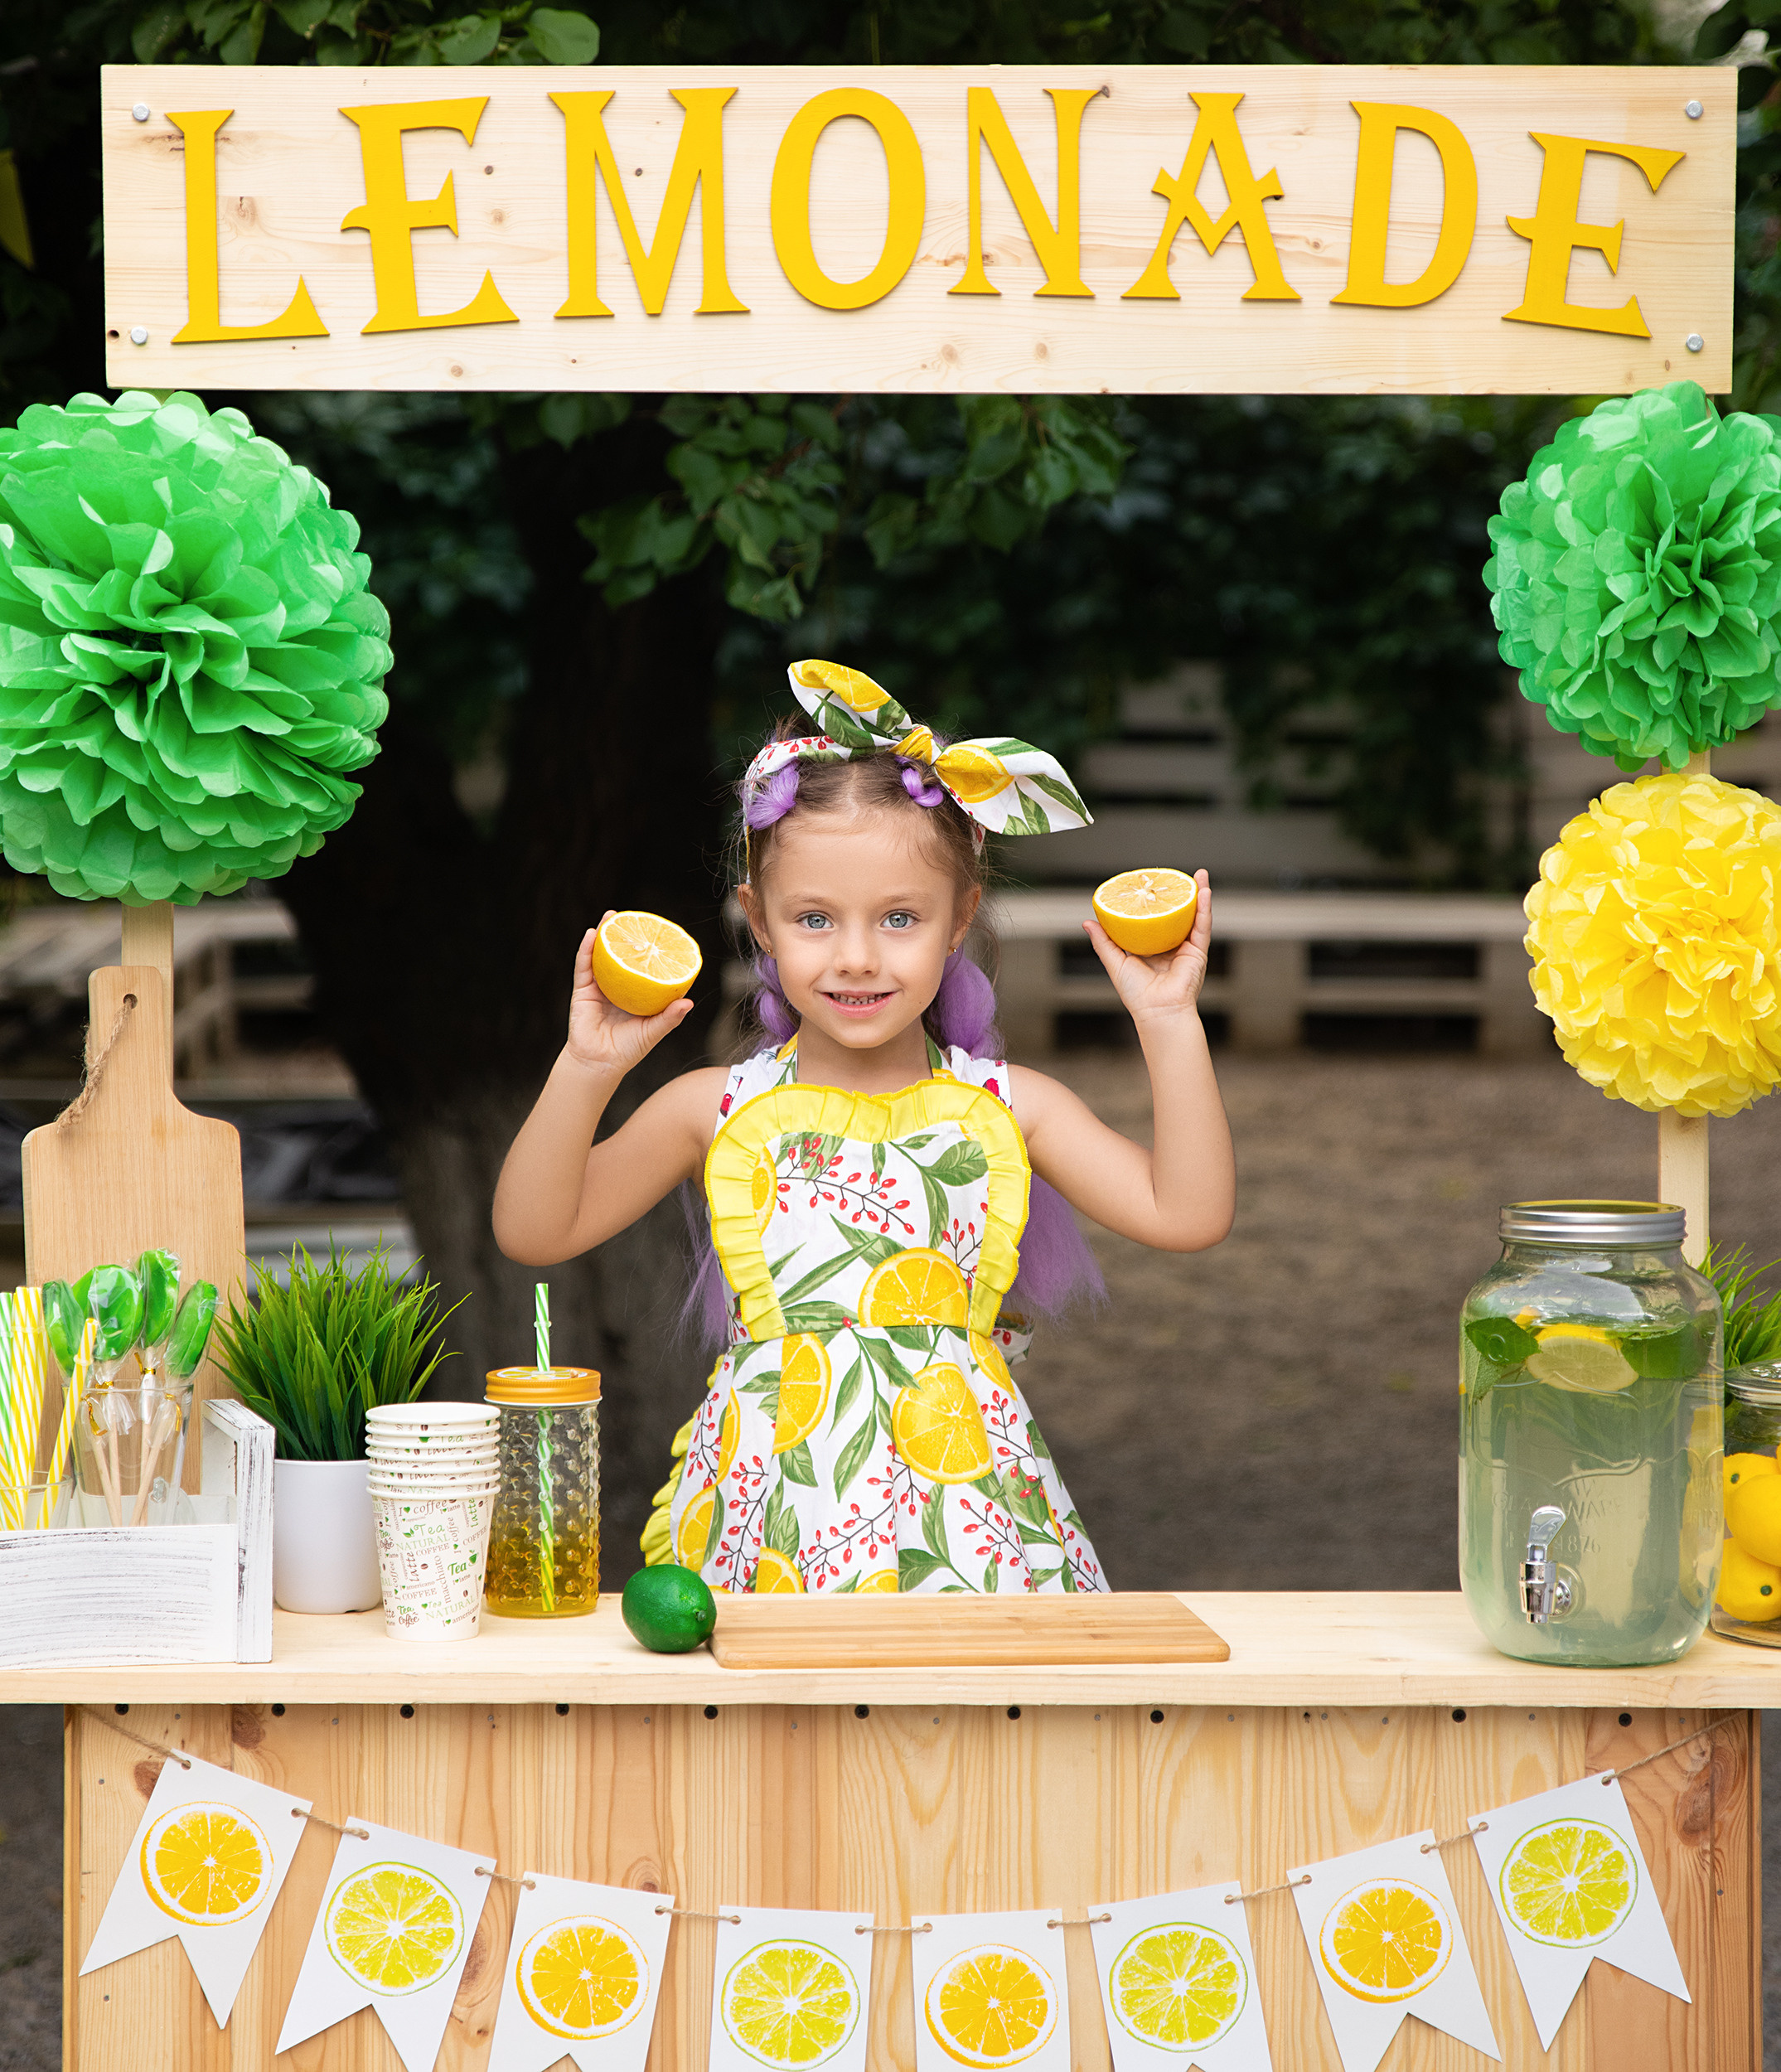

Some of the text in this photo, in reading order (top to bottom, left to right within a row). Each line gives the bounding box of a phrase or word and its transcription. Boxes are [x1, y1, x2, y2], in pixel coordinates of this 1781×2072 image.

[165, 86, 1687, 343] LEMONADE
[414, 1500, 448, 1516] coffee
[467, 1498, 479, 1527] latte
[414, 1524, 445, 1537] Tea
[447, 1517, 459, 1542] coffee
[462, 1525, 487, 1547] COFFEE
[396, 1534, 450, 1552] NATURAL
[416, 1542, 450, 1556] COFFEE
[406, 1552, 419, 1582] latte
[448, 1562, 467, 1576] Tea
[406, 1581, 435, 1590] americano
[434, 1555, 452, 1604] macchiato
[402, 1588, 438, 1600] COFFEE
[397, 1605, 414, 1615] Tea
[425, 1595, 475, 1620] NATURAL
